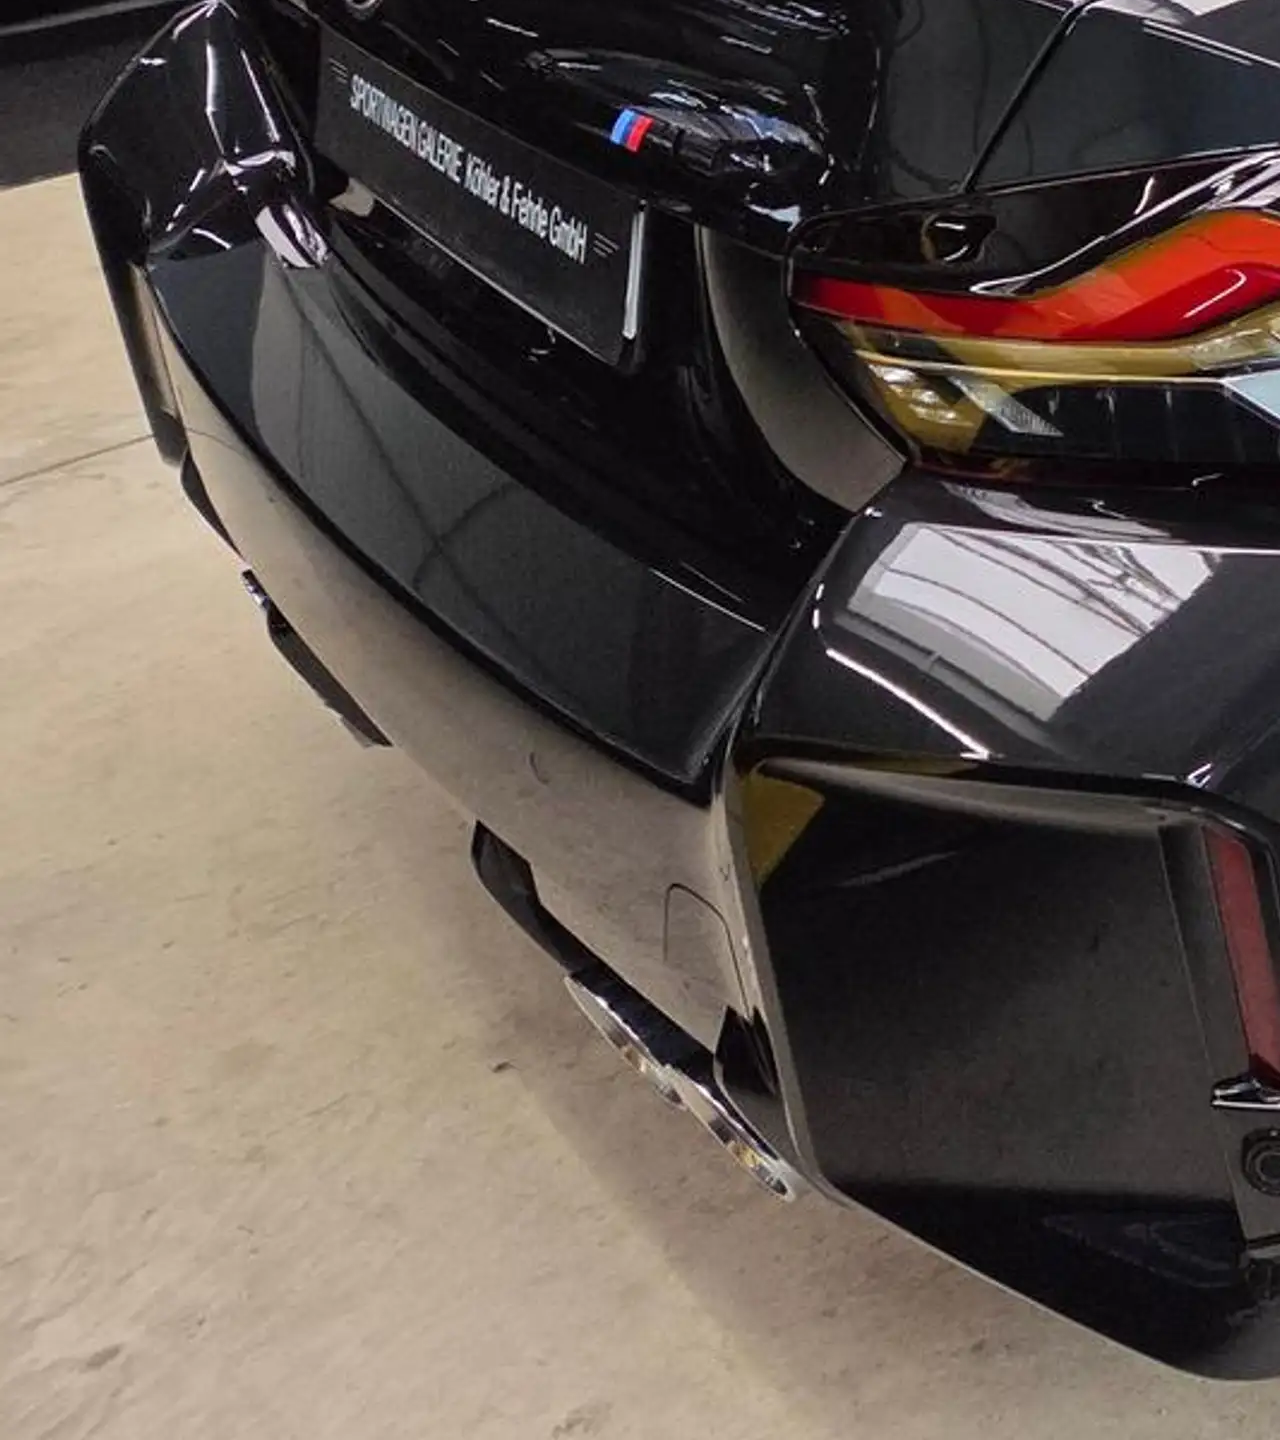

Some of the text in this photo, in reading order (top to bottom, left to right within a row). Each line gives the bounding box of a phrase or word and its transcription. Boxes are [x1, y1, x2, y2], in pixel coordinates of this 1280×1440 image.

[464, 153, 500, 209] Köhler
[500, 175, 511, 215] &
[511, 181, 550, 239] Fehrle
[550, 205, 588, 265] GmbH
